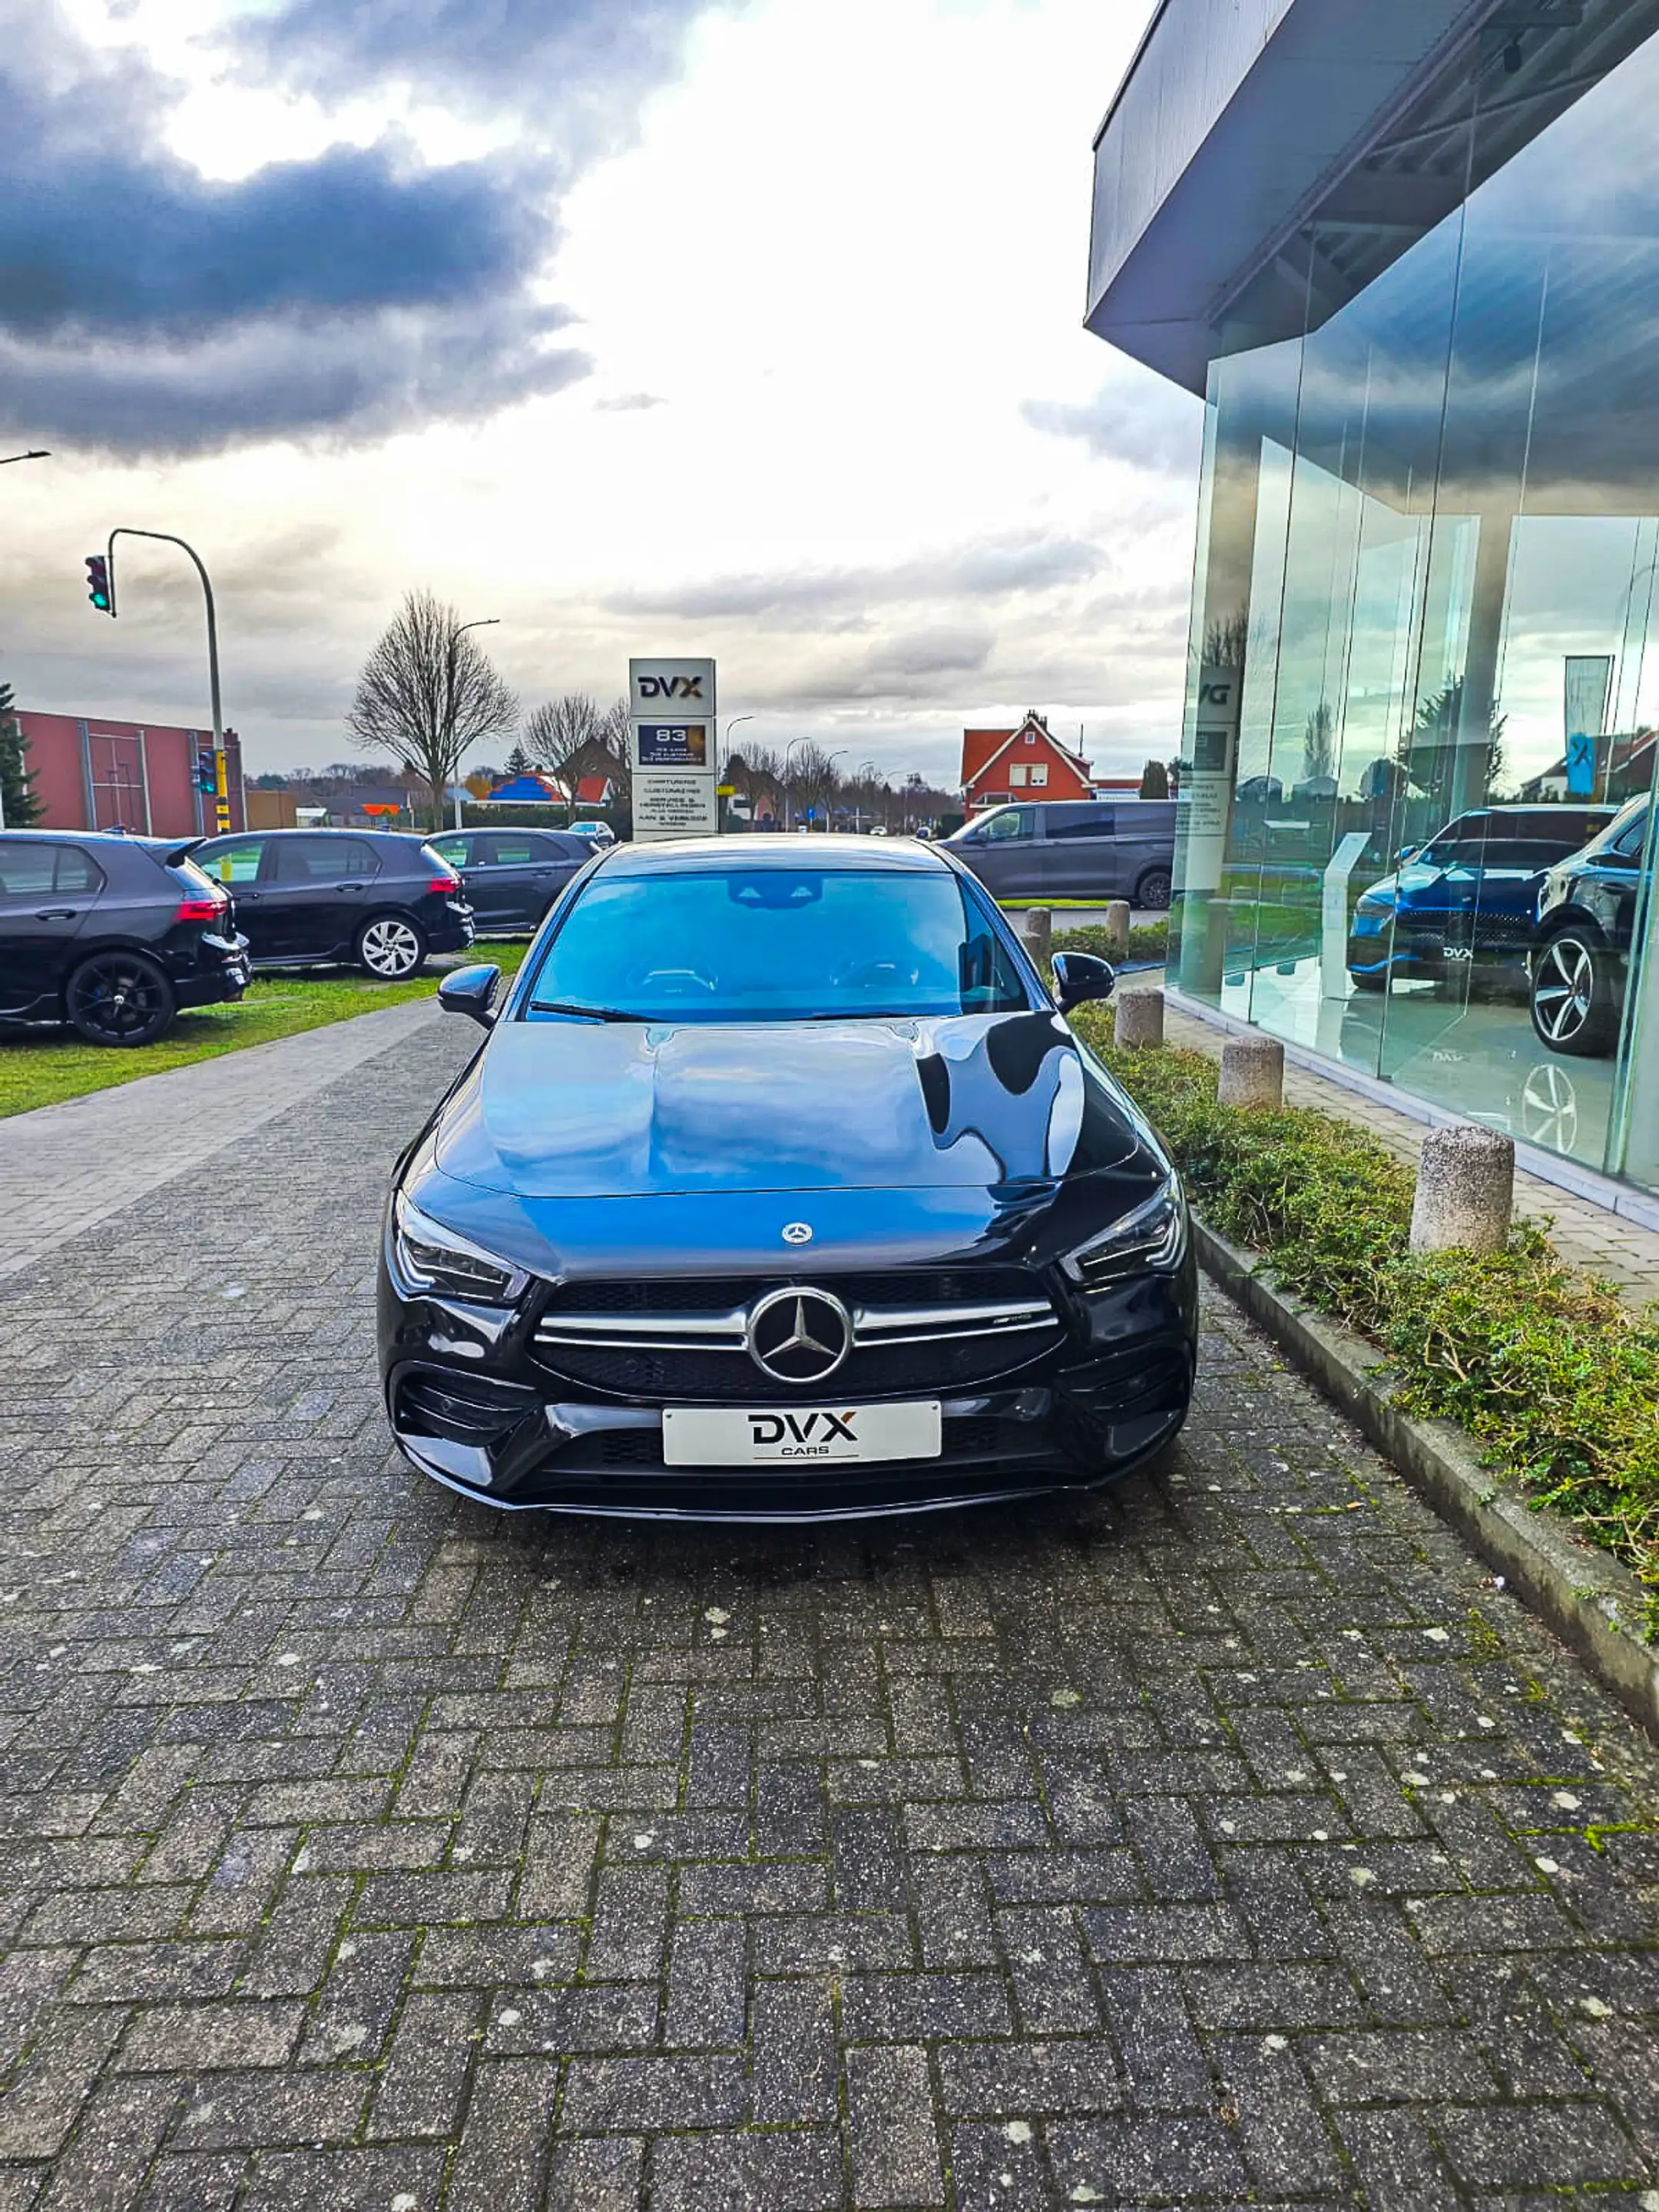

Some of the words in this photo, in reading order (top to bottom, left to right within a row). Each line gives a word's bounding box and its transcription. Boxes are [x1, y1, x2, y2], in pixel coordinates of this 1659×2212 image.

[638, 676, 703, 697] DVX
[656, 729, 687, 742] 83
[1443, 947, 1473, 959] DVX
[748, 1412, 858, 1444] DVX
[781, 1446, 830, 1455] CARS
